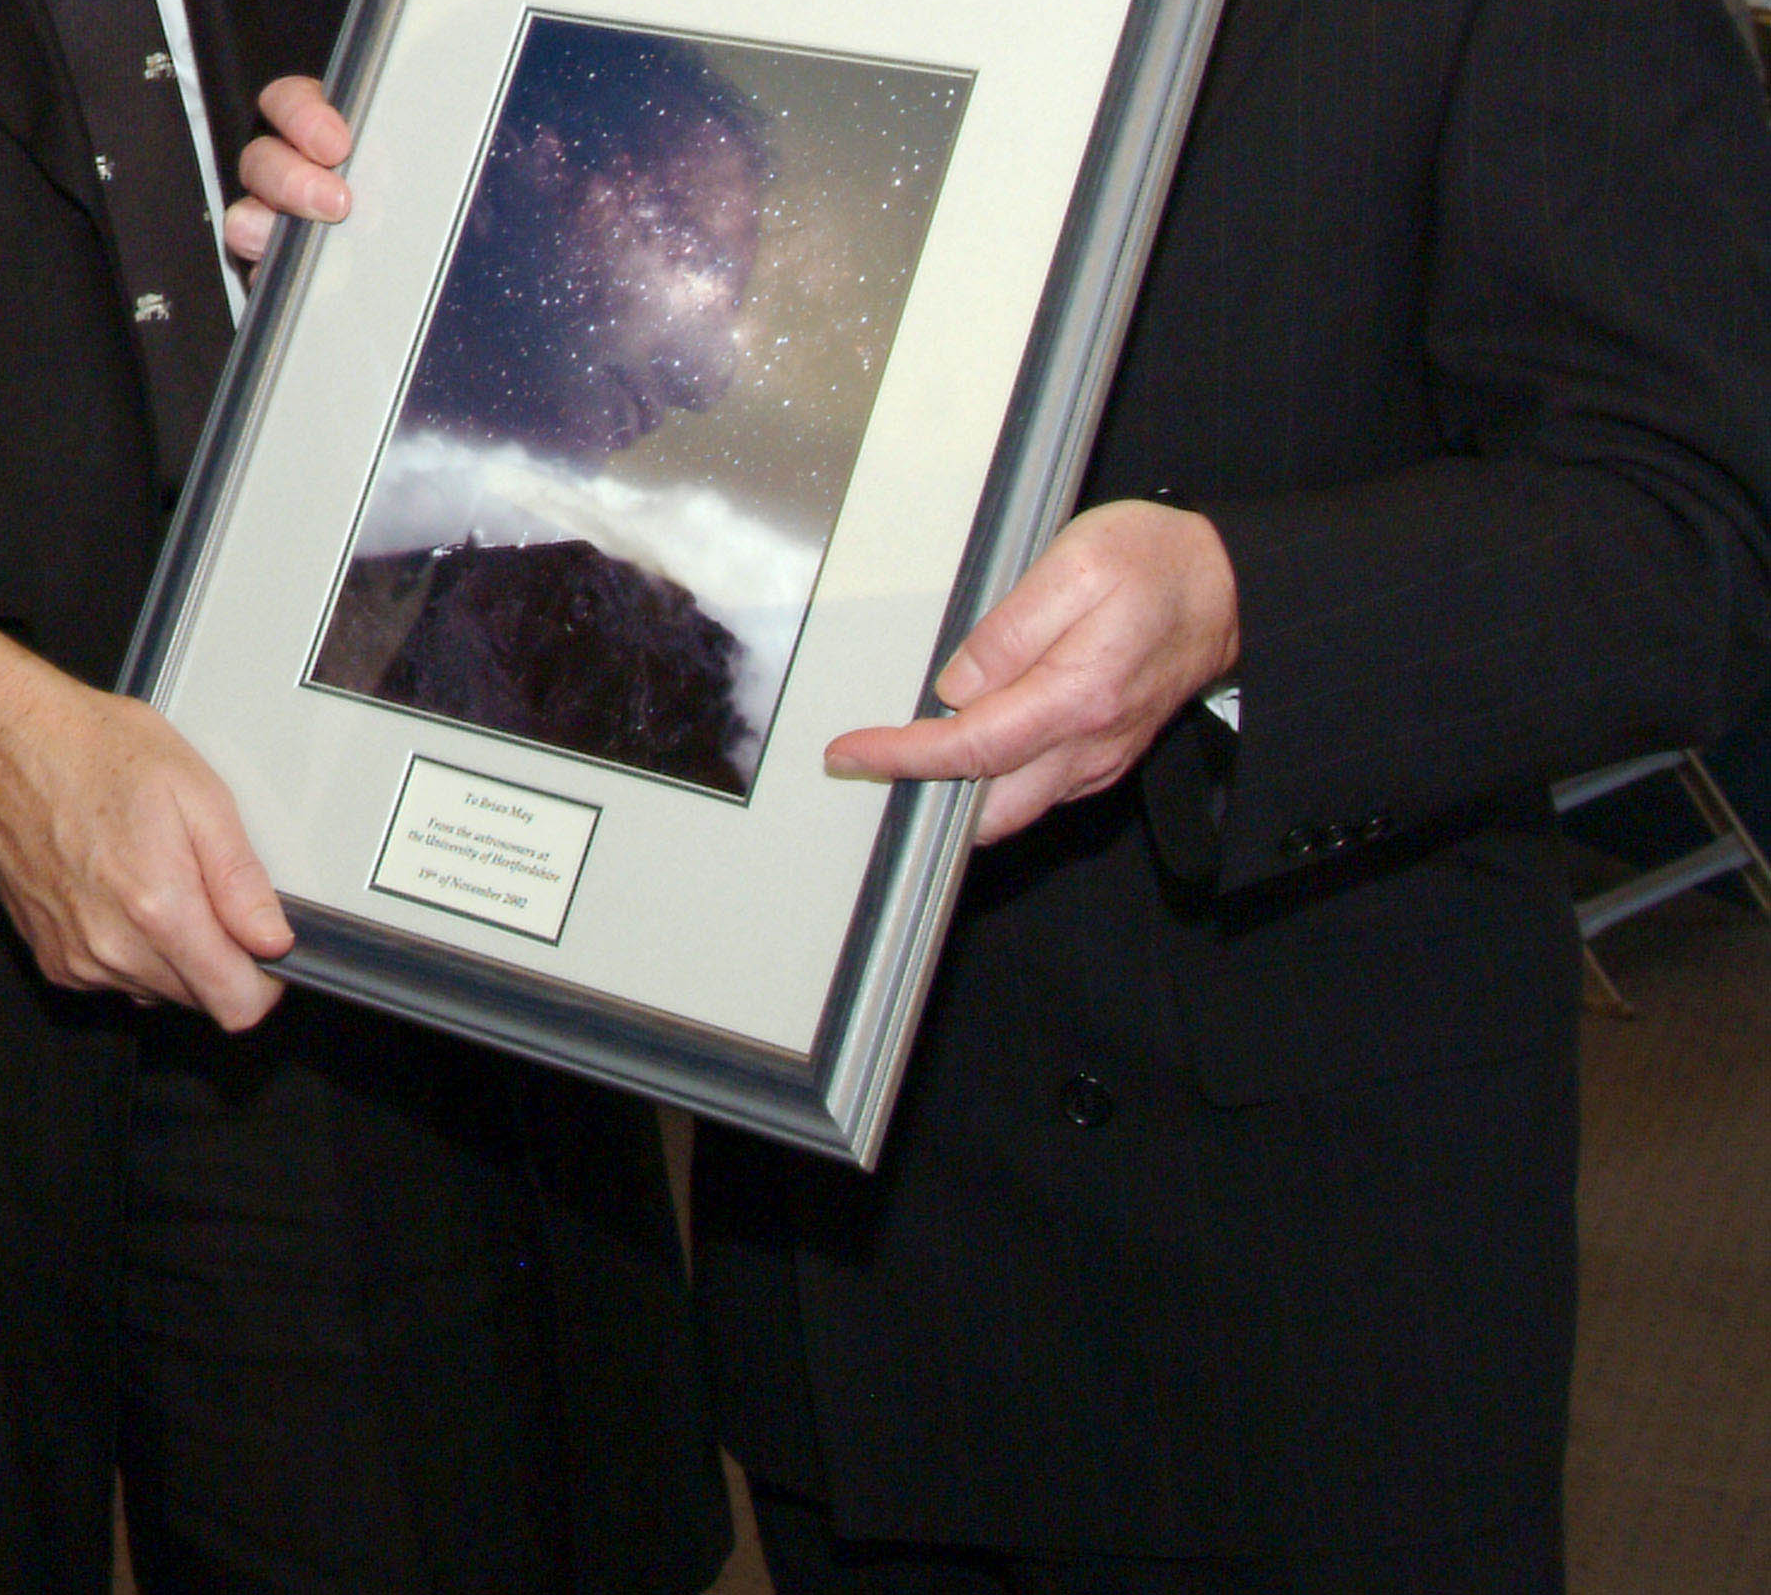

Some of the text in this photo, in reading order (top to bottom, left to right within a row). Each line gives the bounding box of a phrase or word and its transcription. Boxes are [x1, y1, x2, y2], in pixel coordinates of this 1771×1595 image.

[465, 792, 534, 824] To Brian May
[456, 824, 472, 838] the
[407, 829, 561, 882] the University of Hertfordshire
[438, 875, 452, 888] of
[451, 876, 501, 900] November
